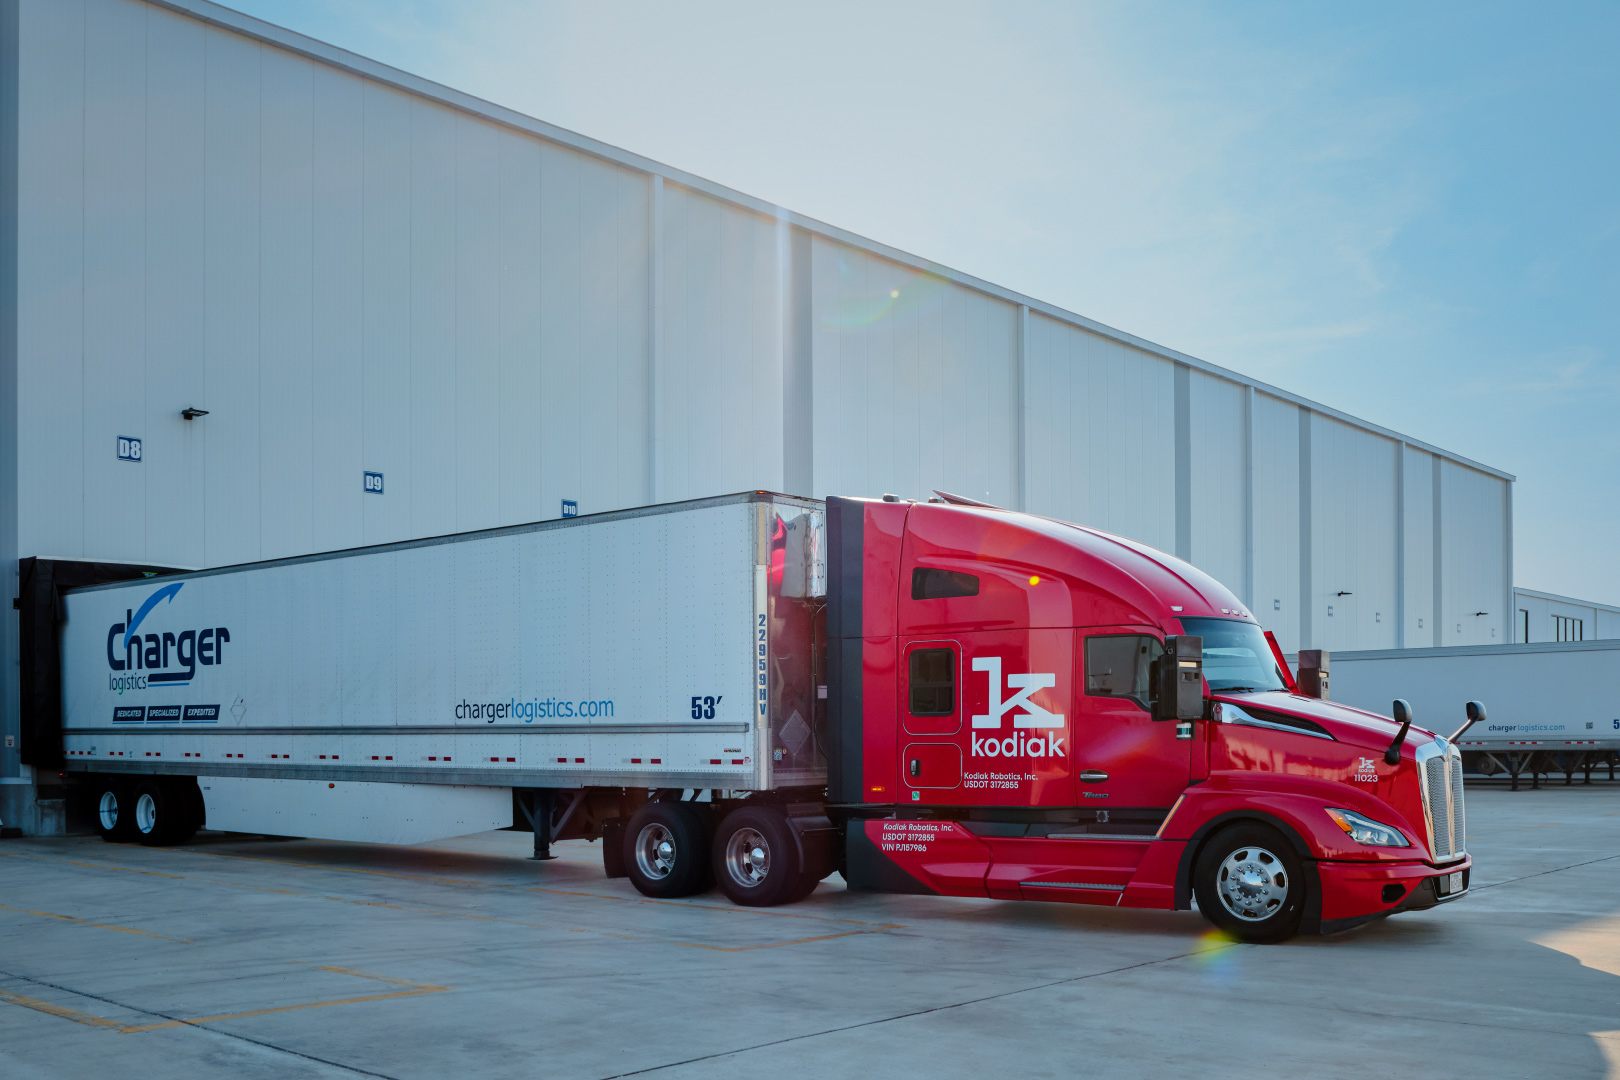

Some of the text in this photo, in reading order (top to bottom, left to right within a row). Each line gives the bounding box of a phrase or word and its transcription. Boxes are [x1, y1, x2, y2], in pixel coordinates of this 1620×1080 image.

[119, 439, 141, 459] D8
[365, 475, 382, 491] D9
[563, 504, 576, 515] D10
[107, 608, 231, 681] Charger
[109, 672, 147, 696] logistics
[116, 709, 143, 718] DEDICATED
[148, 708, 180, 717] SPECIALIZED
[187, 708, 216, 716] EXPEDITED
[455, 697, 614, 724] chargerlogistics.com
[971, 731, 1066, 758] kodiak
[964, 772, 1039, 781] Kodiak Robotics, Inc.
[1354, 774, 1379, 783] 11023
[964, 781, 1019, 789] USDOT 3172855
[883, 823, 954, 832] Kodiak Robotics, Inc.
[882, 833, 935, 842] USDOT 3172855
[881, 843, 895, 851] VIN
